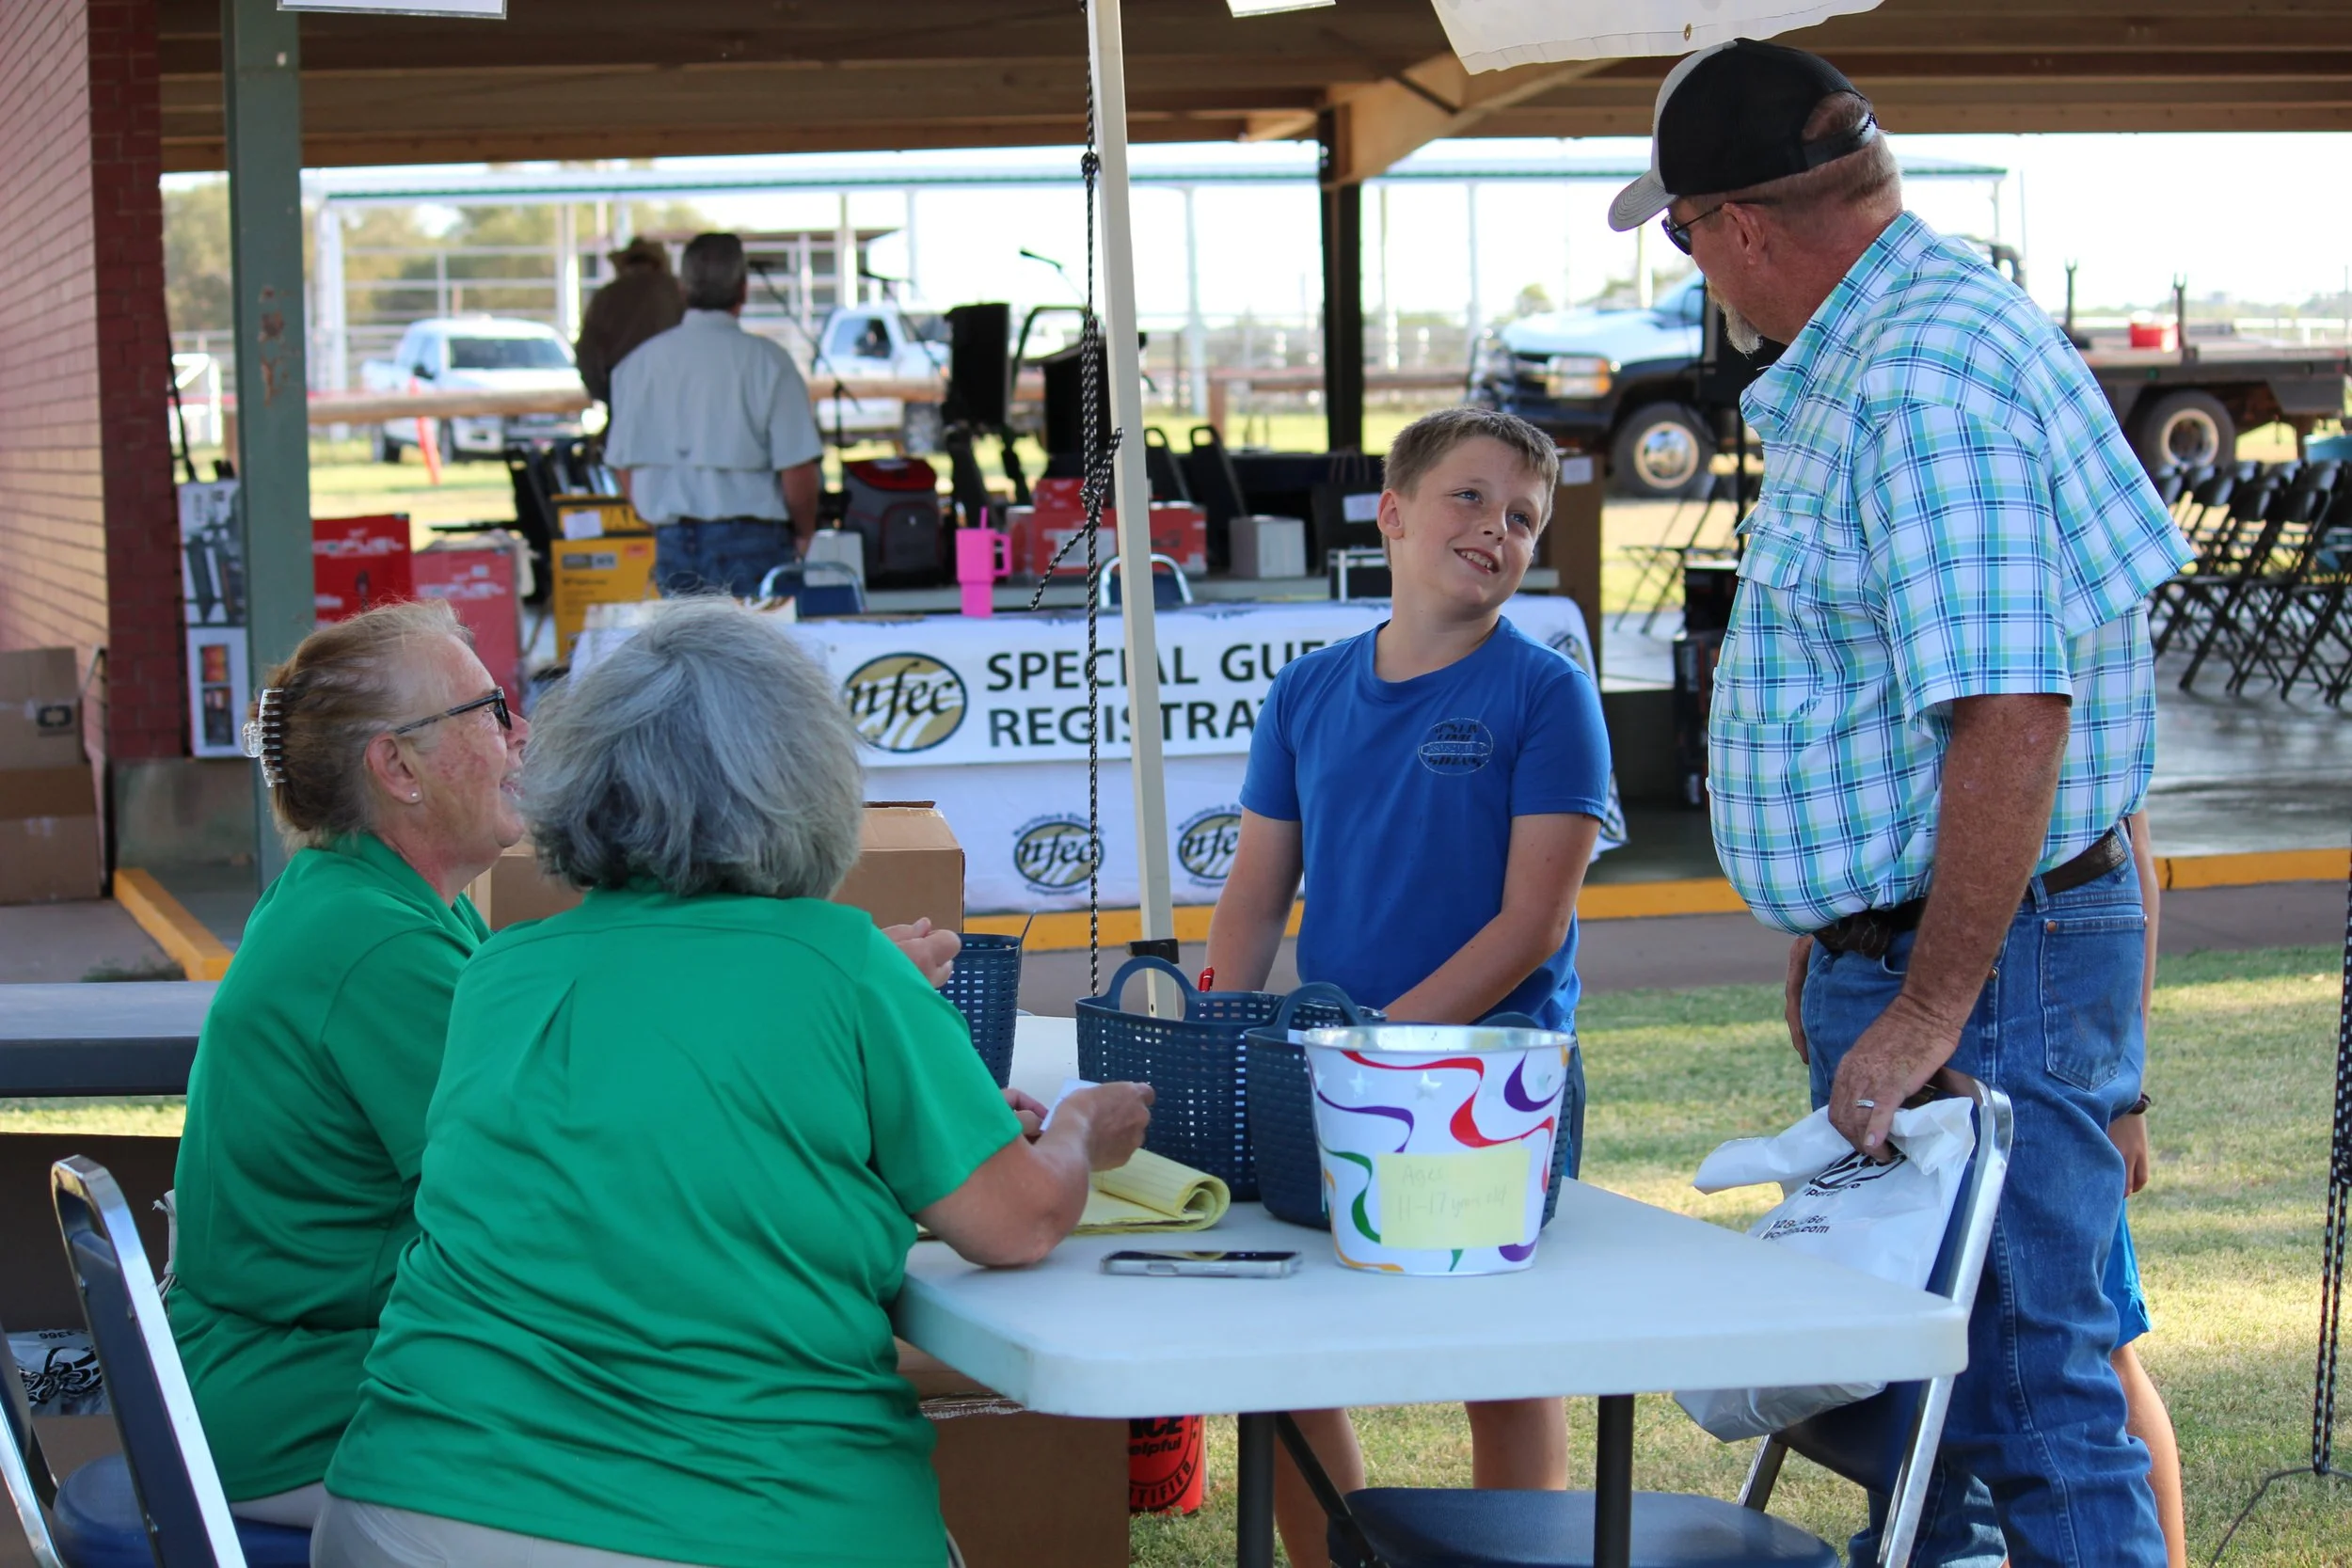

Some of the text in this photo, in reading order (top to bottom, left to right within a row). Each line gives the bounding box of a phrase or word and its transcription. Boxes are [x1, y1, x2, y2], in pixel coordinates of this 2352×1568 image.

[845, 660, 957, 731] nfec
[989, 699, 1266, 748] REGITRA
[1184, 816, 1239, 874] nfe
[1126, 1435, 1183, 1457] elpful
[1129, 1460, 1192, 1504] TIFIED
